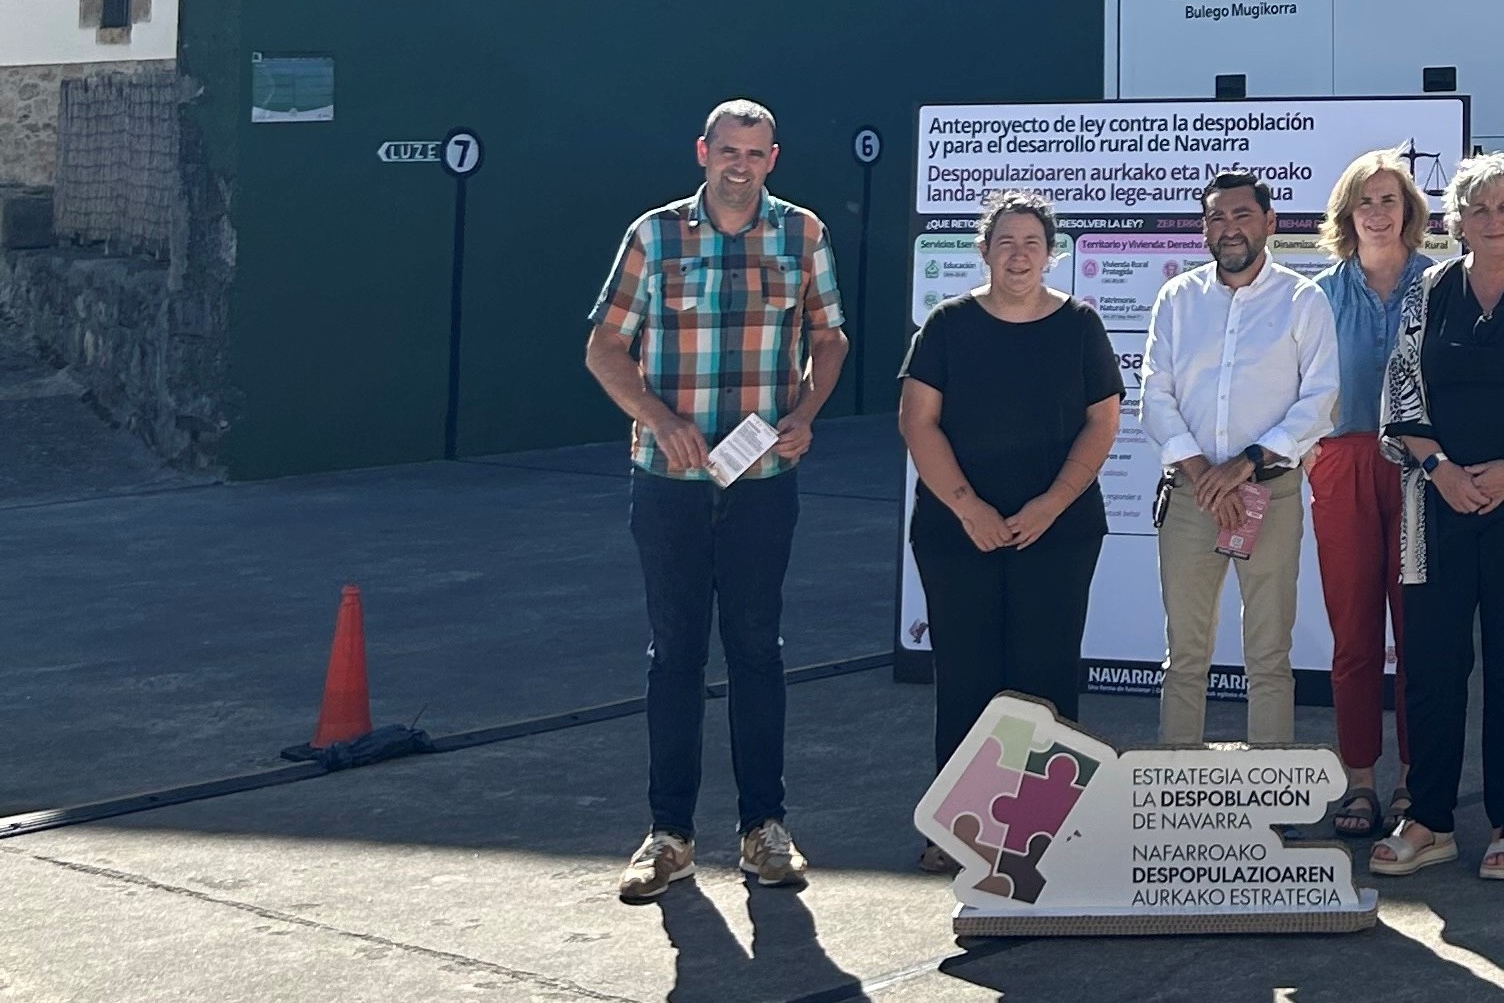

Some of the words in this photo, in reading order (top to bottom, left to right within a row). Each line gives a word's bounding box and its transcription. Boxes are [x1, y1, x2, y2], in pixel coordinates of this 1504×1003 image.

[1185, 5, 1229, 21] Bulego
[1232, 2, 1297, 19] Mugikorra
[929, 117, 1050, 138] Anteproyecto
[1053, 115, 1076, 132] de
[1080, 114, 1106, 137] ley
[1109, 116, 1168, 132] contra
[1173, 114, 1188, 131] la
[1193, 112, 1315, 136] despoblación
[390, 144, 436, 159] LUZE
[454, 140, 472, 167] 7
[862, 135, 873, 157] 6
[928, 140, 940, 158] y
[943, 140, 982, 158] para
[987, 135, 1002, 153] el
[1007, 135, 1095, 153] desarrollo
[1100, 134, 1143, 152] rural
[1147, 134, 1170, 151] de
[1175, 135, 1250, 151] Navarra
[928, 164, 1087, 186] Despopulazioaren
[1091, 163, 1166, 180] aurkako
[1171, 164, 1200, 180] eta
[1108, 219, 1120, 228] LA
[1121, 219, 1144, 228] LEY?
[1156, 219, 1176, 228] ZER
[921, 240, 955, 248] Servicios
[1082, 239, 1120, 249] Territorio
[1121, 242, 1127, 251] y
[1128, 239, 1165, 249] Vivienda:
[1167, 239, 1202, 249] Derecho
[1133, 768, 1244, 785] ESTRATEGIA
[1248, 767, 1329, 785] CONTRA
[1133, 791, 1156, 807] LA
[1161, 785, 1310, 807] DESPOBLACIÓN
[1133, 812, 1156, 829] DE
[1161, 812, 1252, 829] NAVARRA
[1132, 844, 1266, 861] NAFARROAKO
[1132, 866, 1334, 883] DESPOPULAZIOAREN
[1131, 889, 1224, 906] AURKAKO
[1230, 888, 1341, 906] ESTRATEGIA
